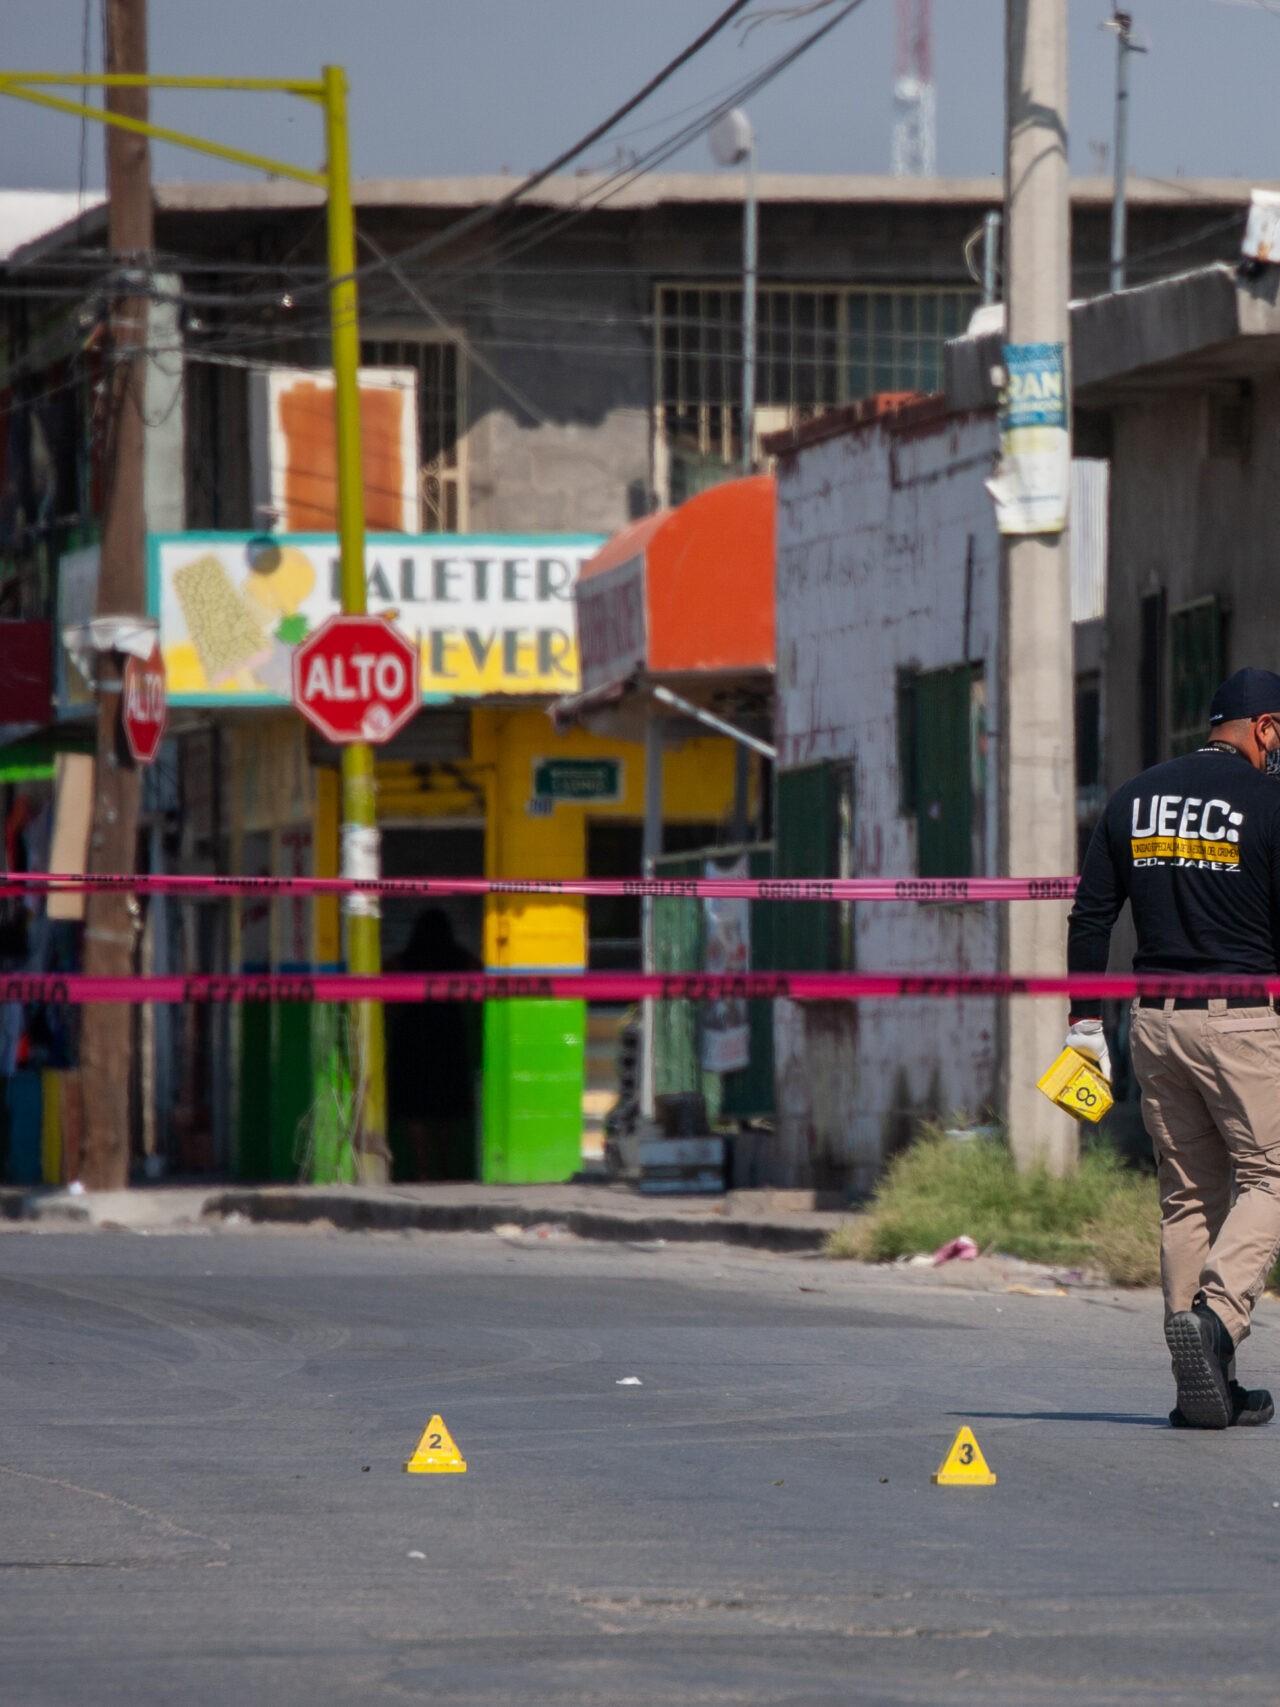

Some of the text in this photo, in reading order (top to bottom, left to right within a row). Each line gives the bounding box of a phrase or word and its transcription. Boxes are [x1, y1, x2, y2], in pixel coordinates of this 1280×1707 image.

[329, 556, 591, 602] ALETER
[415, 625, 574, 678] EVER
[127, 671, 164, 722] ALTO
[304, 652, 406, 701] ALTO
[1075, 1086, 1097, 1107] 8
[428, 1433, 442, 1449] 2
[959, 1443, 973, 1465] 3
